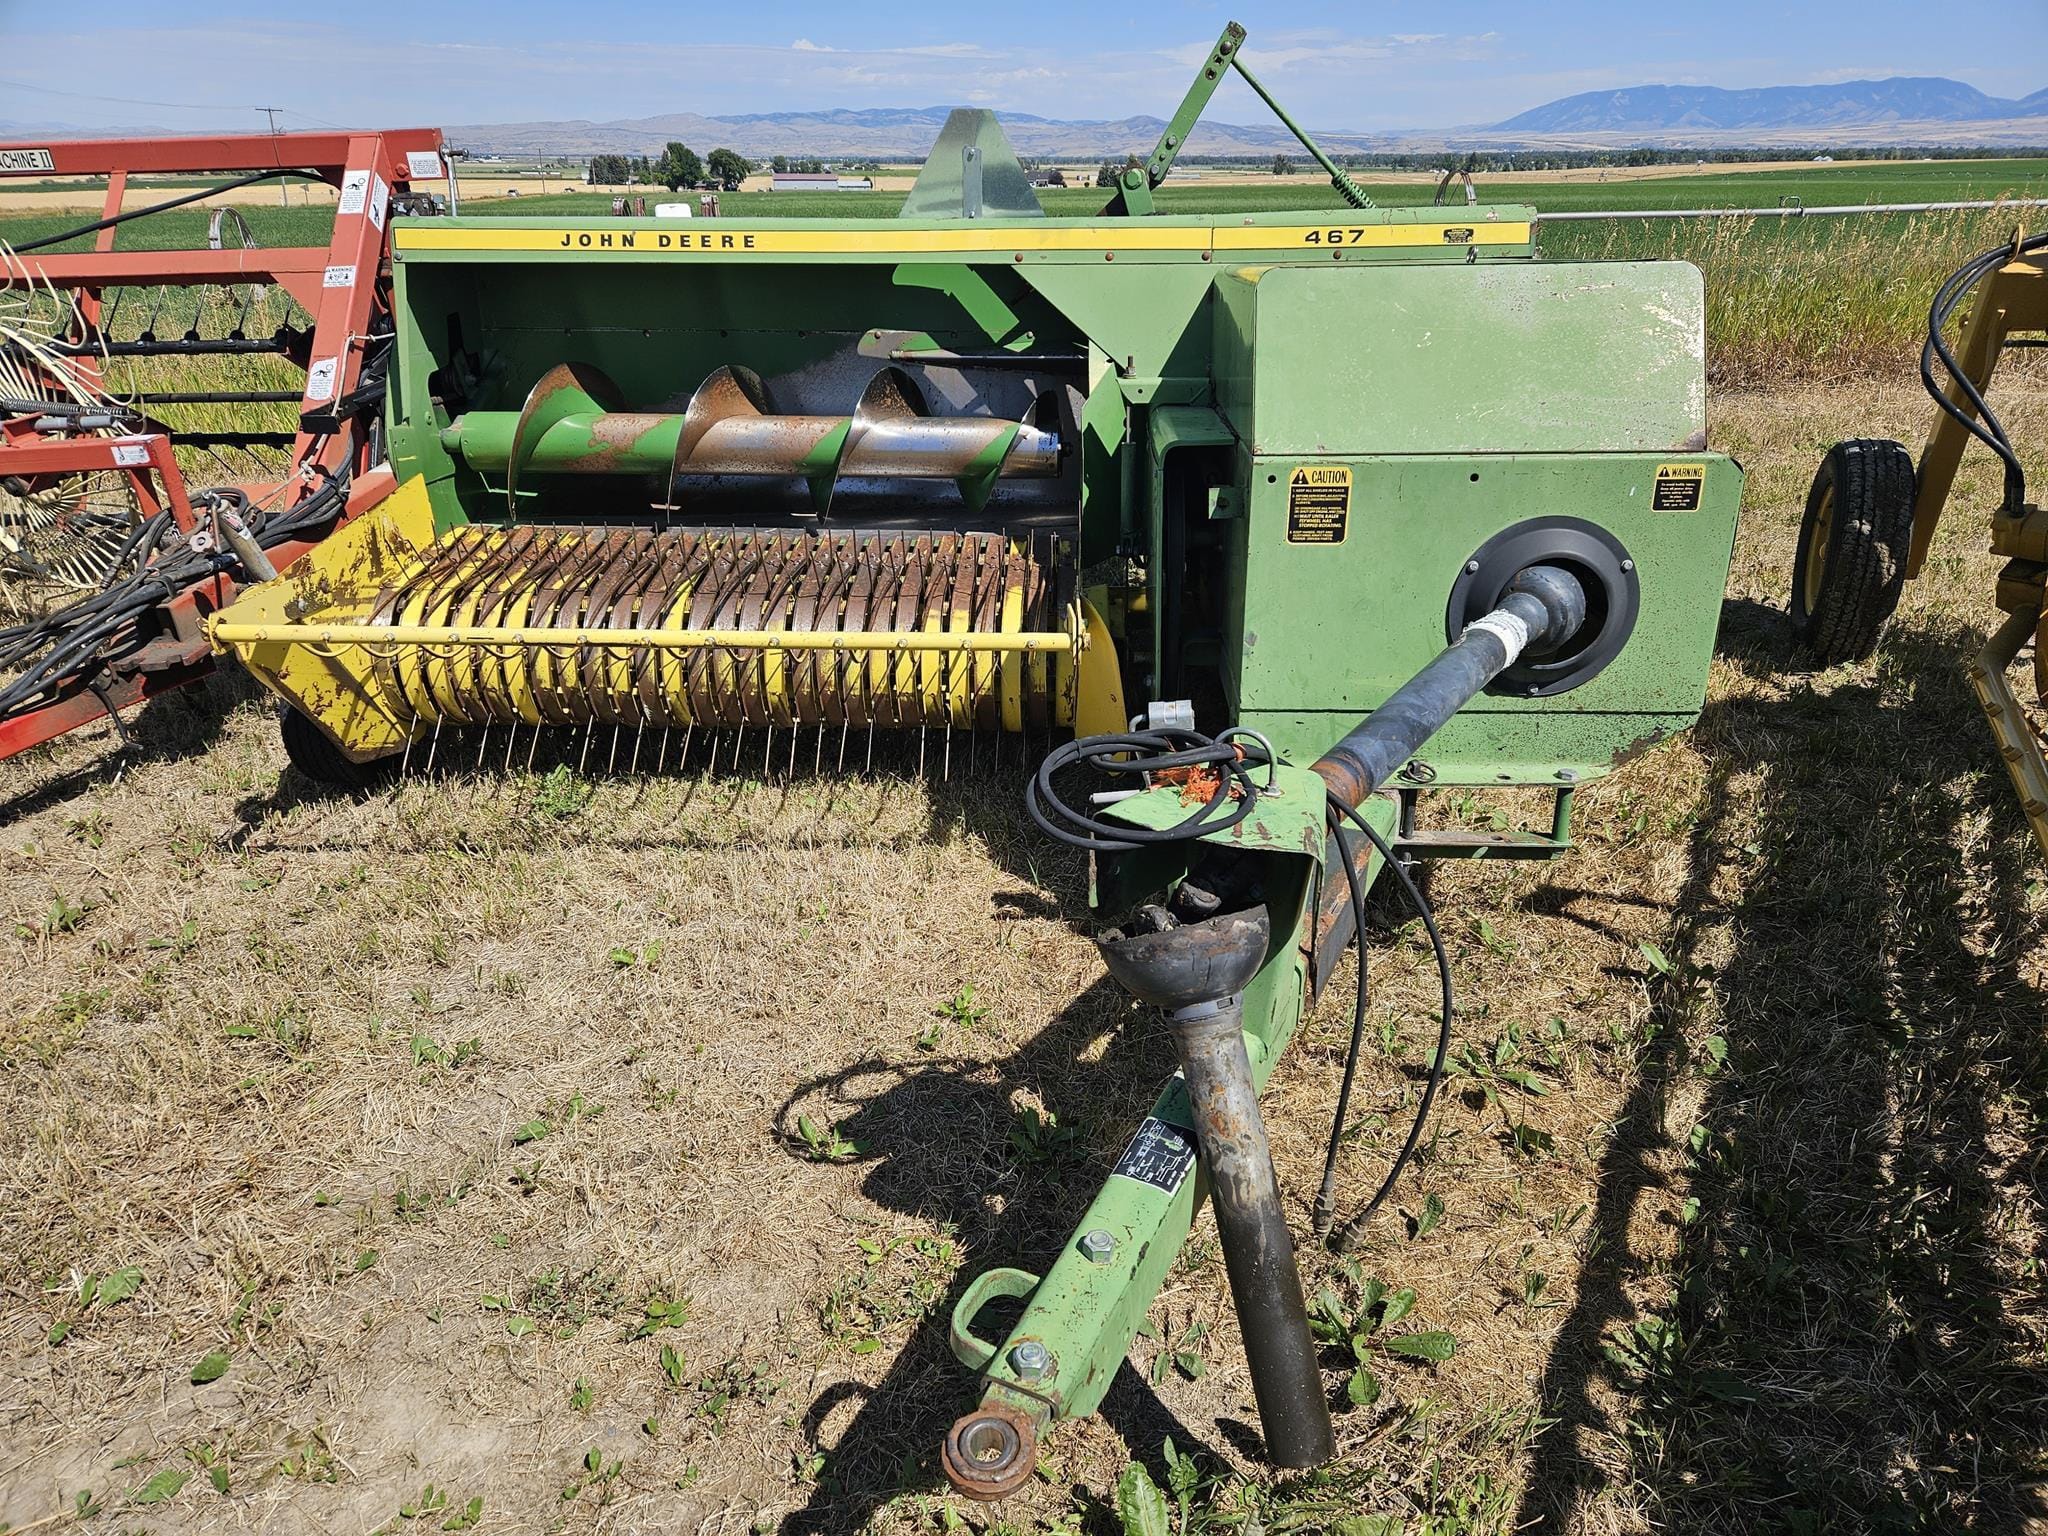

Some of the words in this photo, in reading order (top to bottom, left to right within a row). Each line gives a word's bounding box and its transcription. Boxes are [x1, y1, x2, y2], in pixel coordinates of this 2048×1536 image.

[561, 233, 635, 247] JOHN
[658, 234, 755, 248] DEERE
[1304, 229, 1365, 244] 467
[1311, 470, 1347, 484] CAUTION
[1671, 467, 1703, 478] WARNING
